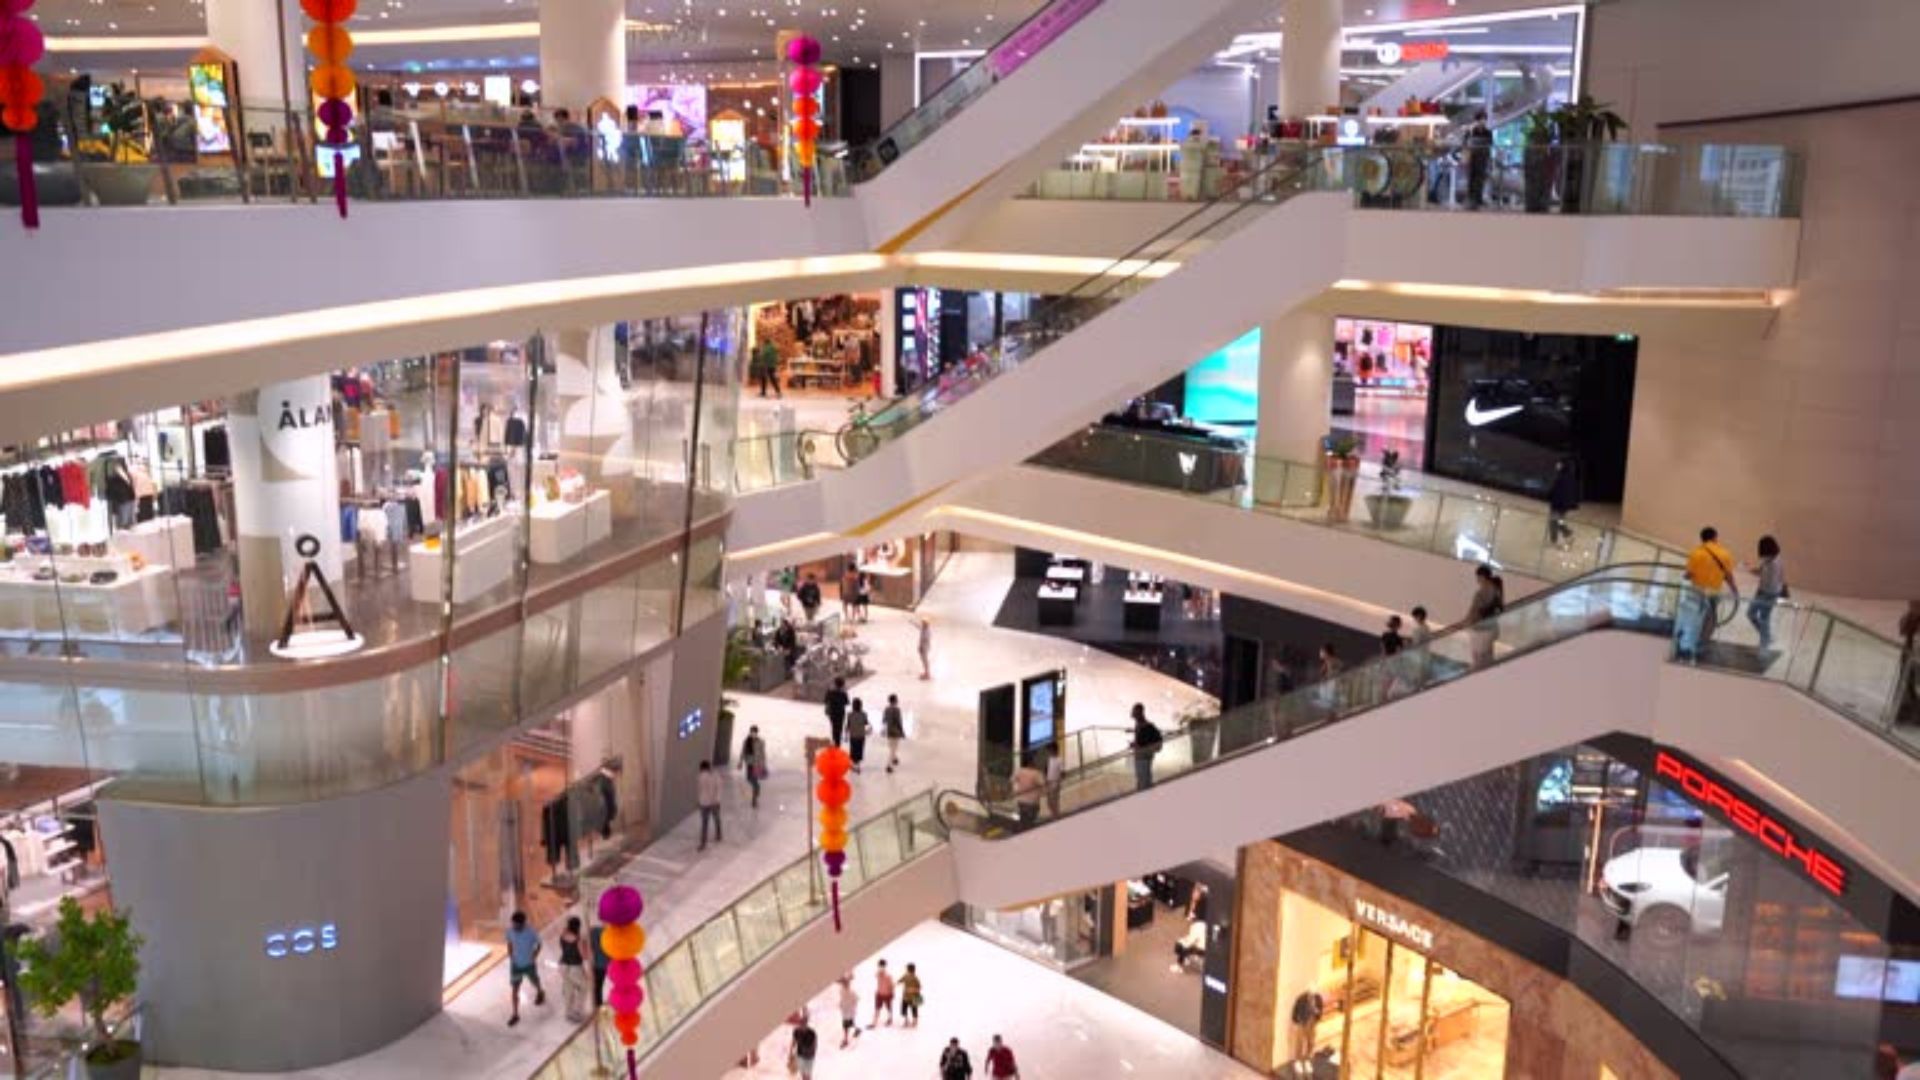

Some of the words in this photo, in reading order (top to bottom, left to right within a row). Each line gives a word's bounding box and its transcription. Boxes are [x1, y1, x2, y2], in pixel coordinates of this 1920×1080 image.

[1655, 751, 1846, 897] PORSCHE
[266, 923, 337, 957] COS
[1355, 897, 1435, 949] VERSACE
